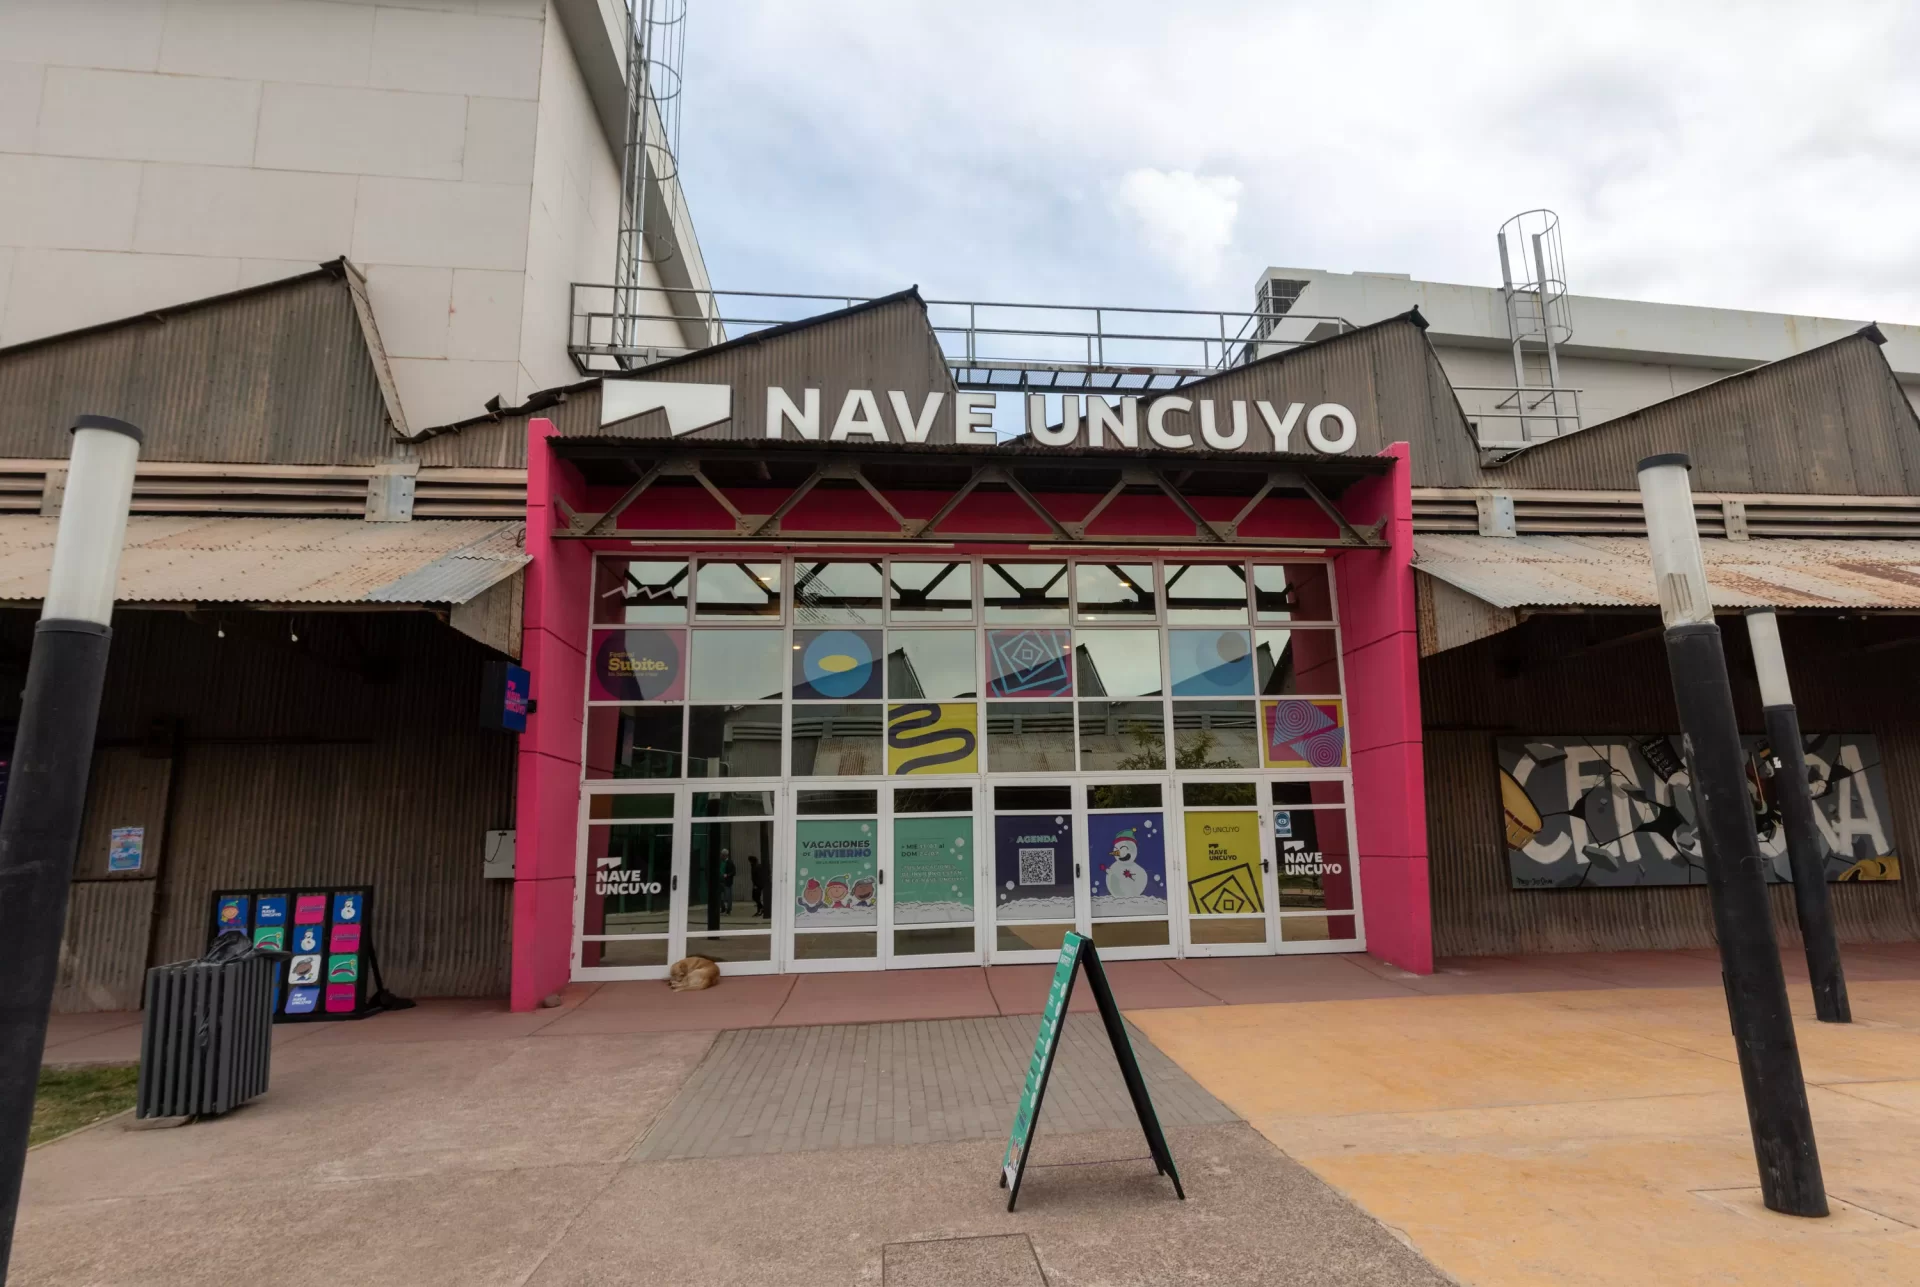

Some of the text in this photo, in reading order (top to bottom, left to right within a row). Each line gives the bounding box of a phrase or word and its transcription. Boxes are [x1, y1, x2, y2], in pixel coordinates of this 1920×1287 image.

[766, 386, 1358, 455] NAVE UNCUYO
[608, 657, 669, 671] Subite.
[1509, 743, 1890, 865] CENRA
[802, 839, 870, 849] VACACIONES
[1016, 834, 1058, 843] AGENDA
[814, 848, 872, 859] INVIERNO
[1284, 852, 1323, 864] NAVE
[596, 869, 641, 883] NAVE
[1285, 863, 1342, 876] UNCUYO
[595, 882, 662, 896] UNCUYO
